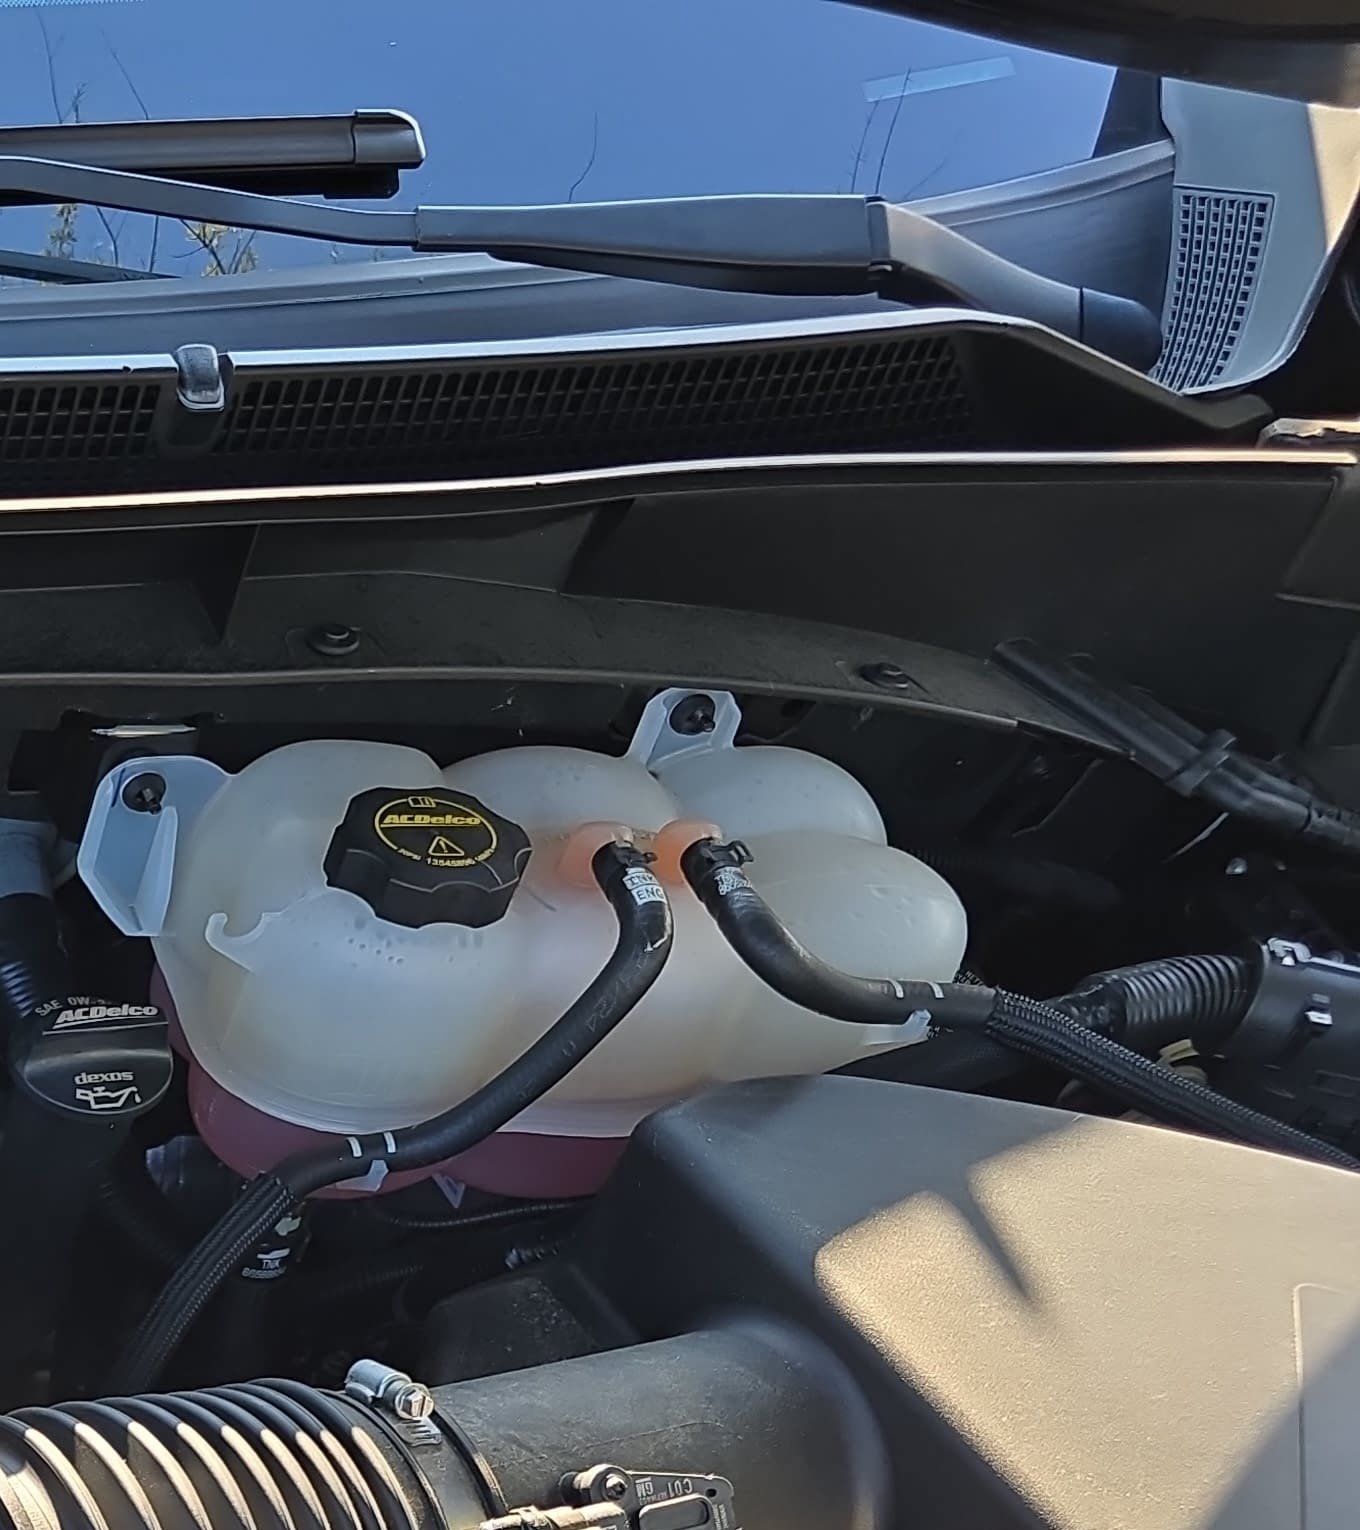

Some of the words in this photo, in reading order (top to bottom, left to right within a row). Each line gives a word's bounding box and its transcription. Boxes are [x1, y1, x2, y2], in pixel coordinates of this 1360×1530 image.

[382, 815, 481, 826] ACDelco
[636, 887, 665, 900] ENG
[35, 1000, 62, 1016] SAE
[54, 1004, 159, 1024] ACDelco
[74, 1072, 134, 1085] dexos
[635, 1480, 654, 1497] GM
